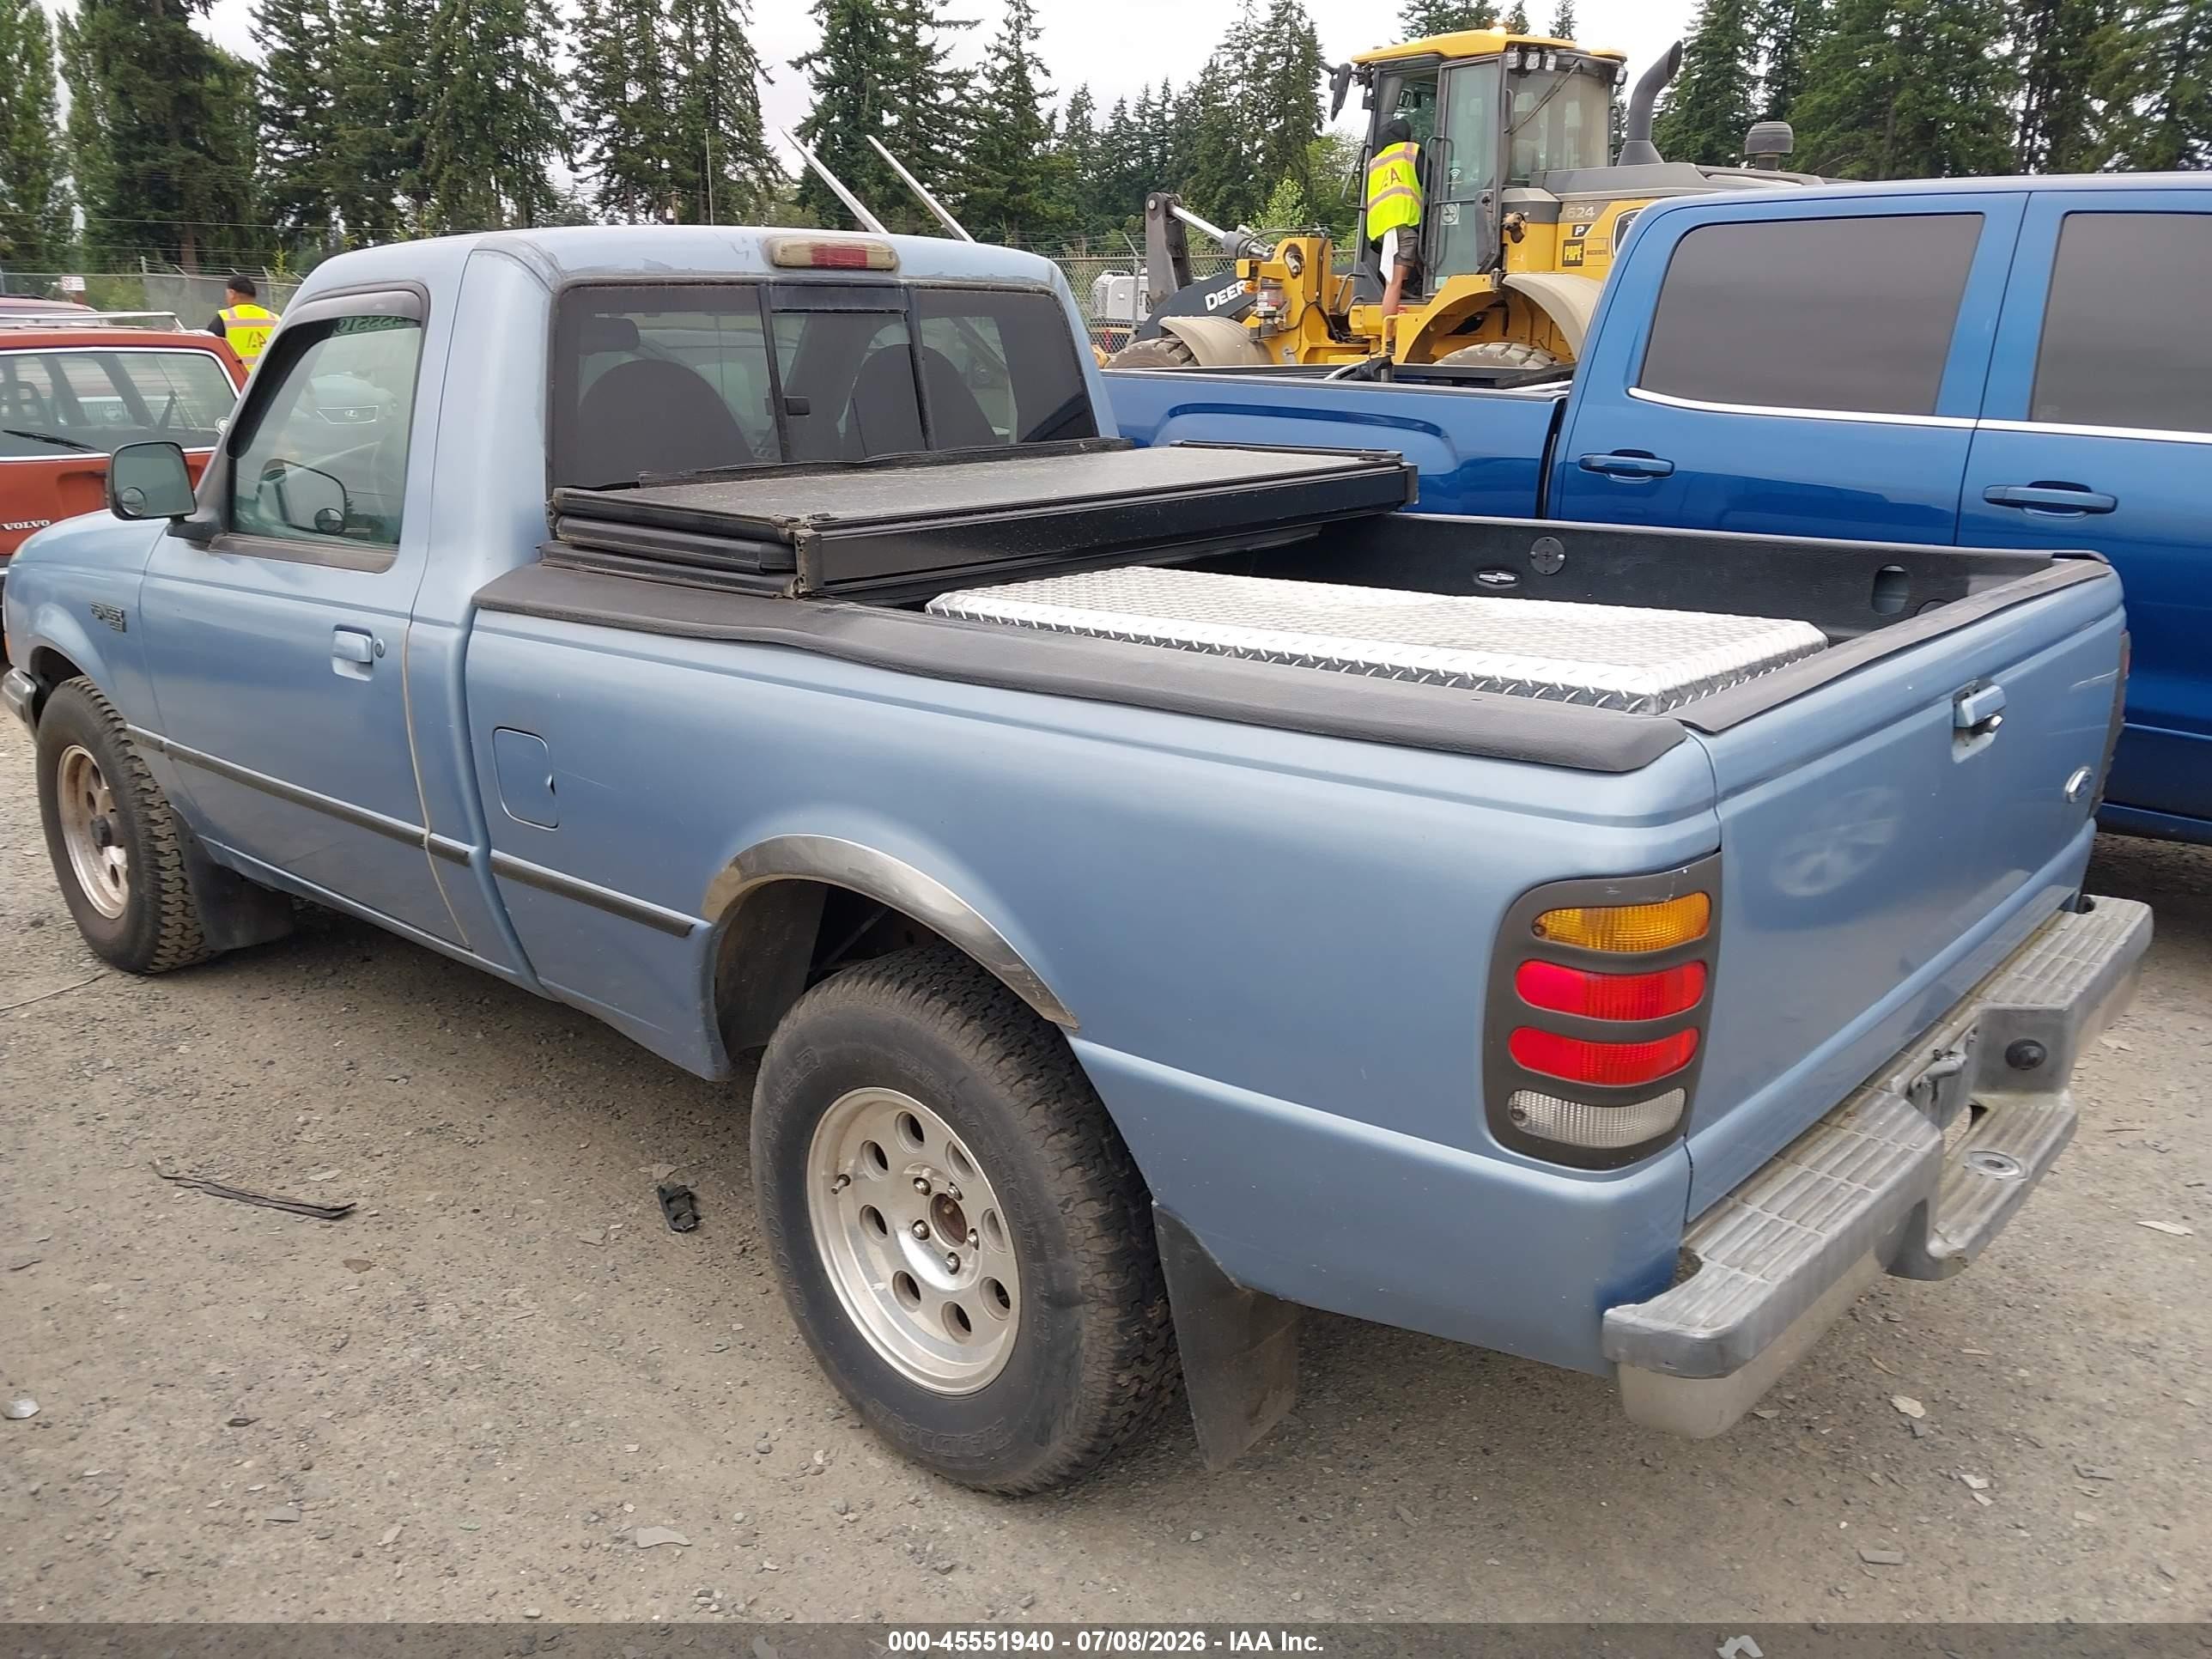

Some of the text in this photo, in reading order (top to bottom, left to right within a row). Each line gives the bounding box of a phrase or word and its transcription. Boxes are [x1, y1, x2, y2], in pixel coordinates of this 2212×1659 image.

[1565, 206, 1595, 221] 624
[1574, 225, 1585, 236] P
[1204, 279, 1248, 312] DEER
[1, 520, 51, 531] VOLVO
